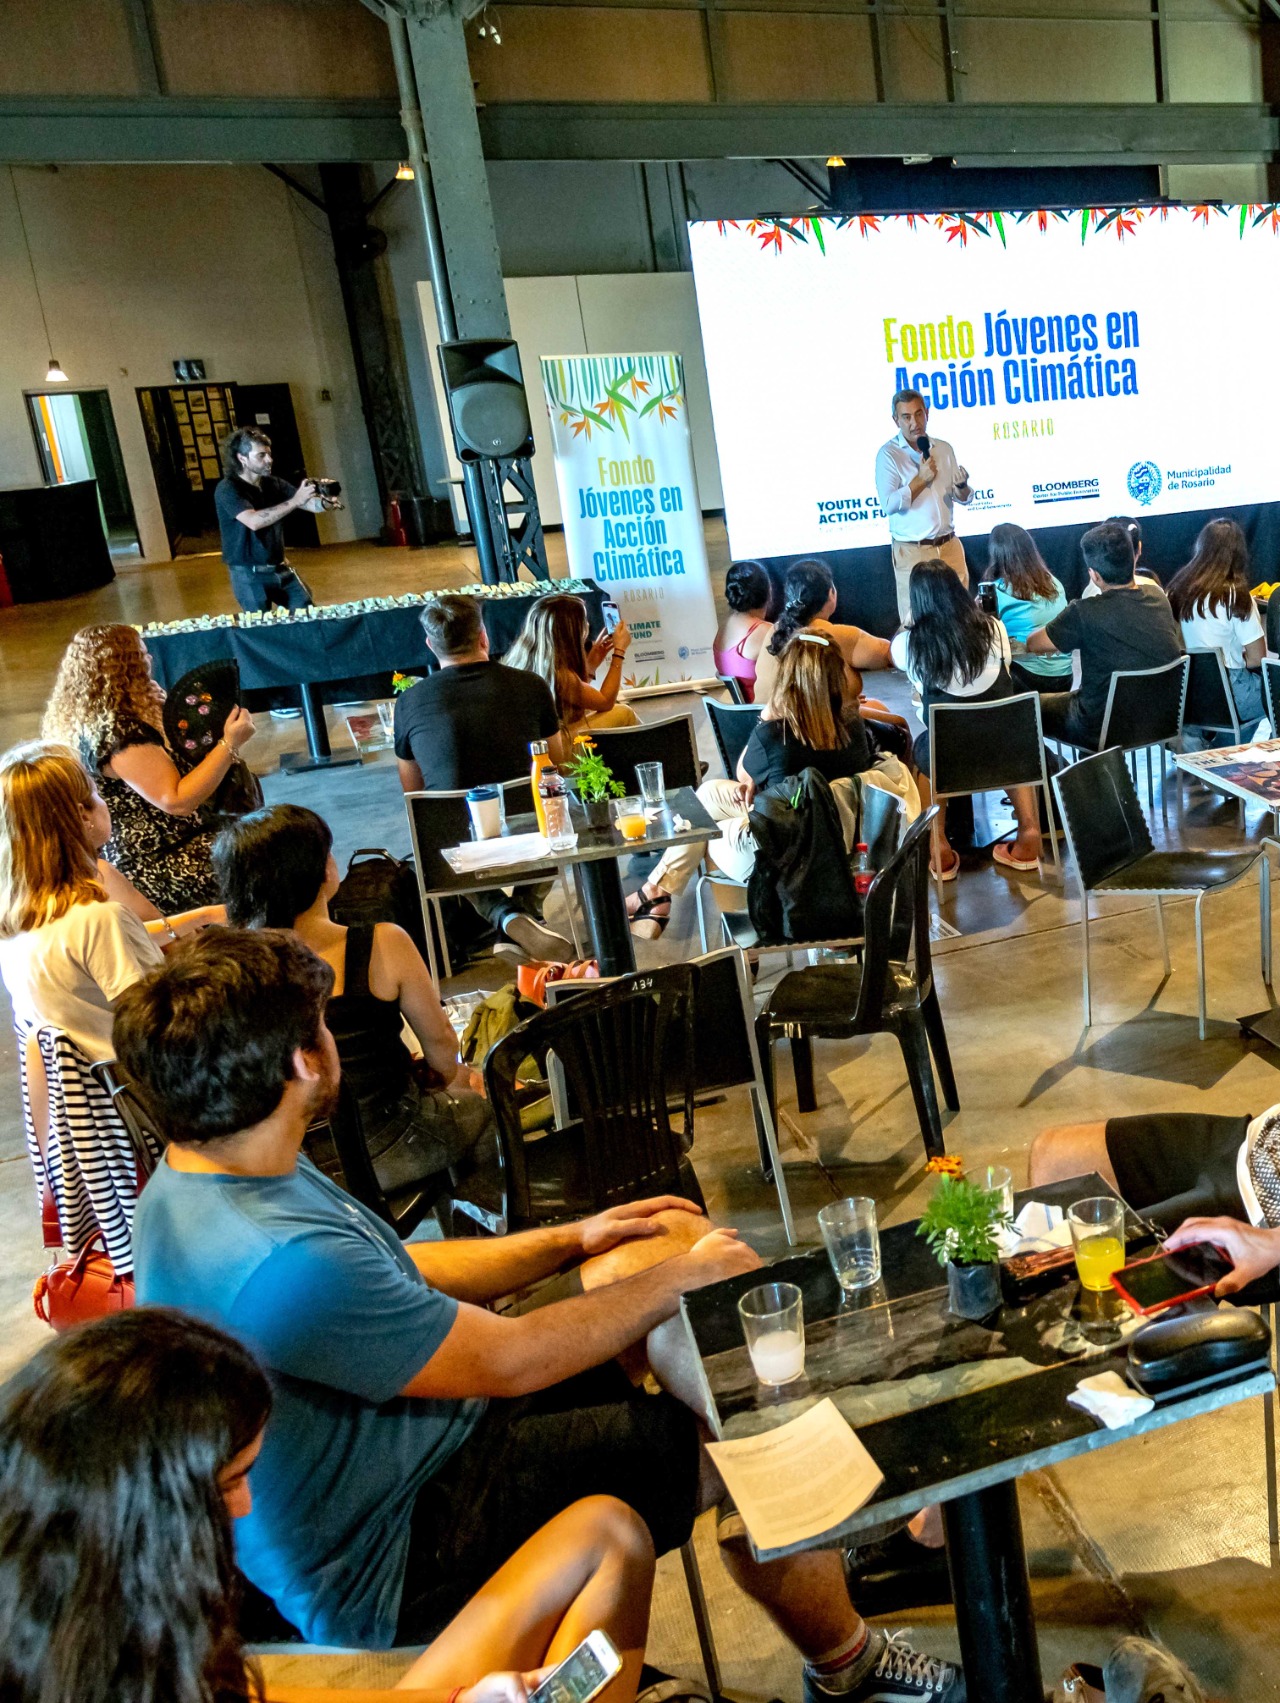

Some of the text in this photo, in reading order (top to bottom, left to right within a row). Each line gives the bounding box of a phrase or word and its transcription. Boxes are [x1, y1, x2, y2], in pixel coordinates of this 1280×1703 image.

[883, 309, 1140, 363] Fondo Jóvenes en
[1003, 353, 1139, 404] Climática
[993, 418, 1055, 440] ROSARIO
[597, 454, 655, 487] Fondo
[1167, 464, 1232, 480] Municipalidad
[1032, 478, 1099, 493] BLOOMBERG
[1168, 477, 1215, 490] de Rosario
[974, 488, 995, 500] CLG
[578, 486, 683, 519] Jóvenes en
[817, 496, 881, 512] YOUTH CL
[818, 509, 887, 524] ACTION FU
[603, 515, 668, 549] Acción
[593, 547, 686, 582] Climática
[623, 587, 665, 603] ROSARIO
[627, 620, 661, 631] LIMATE
